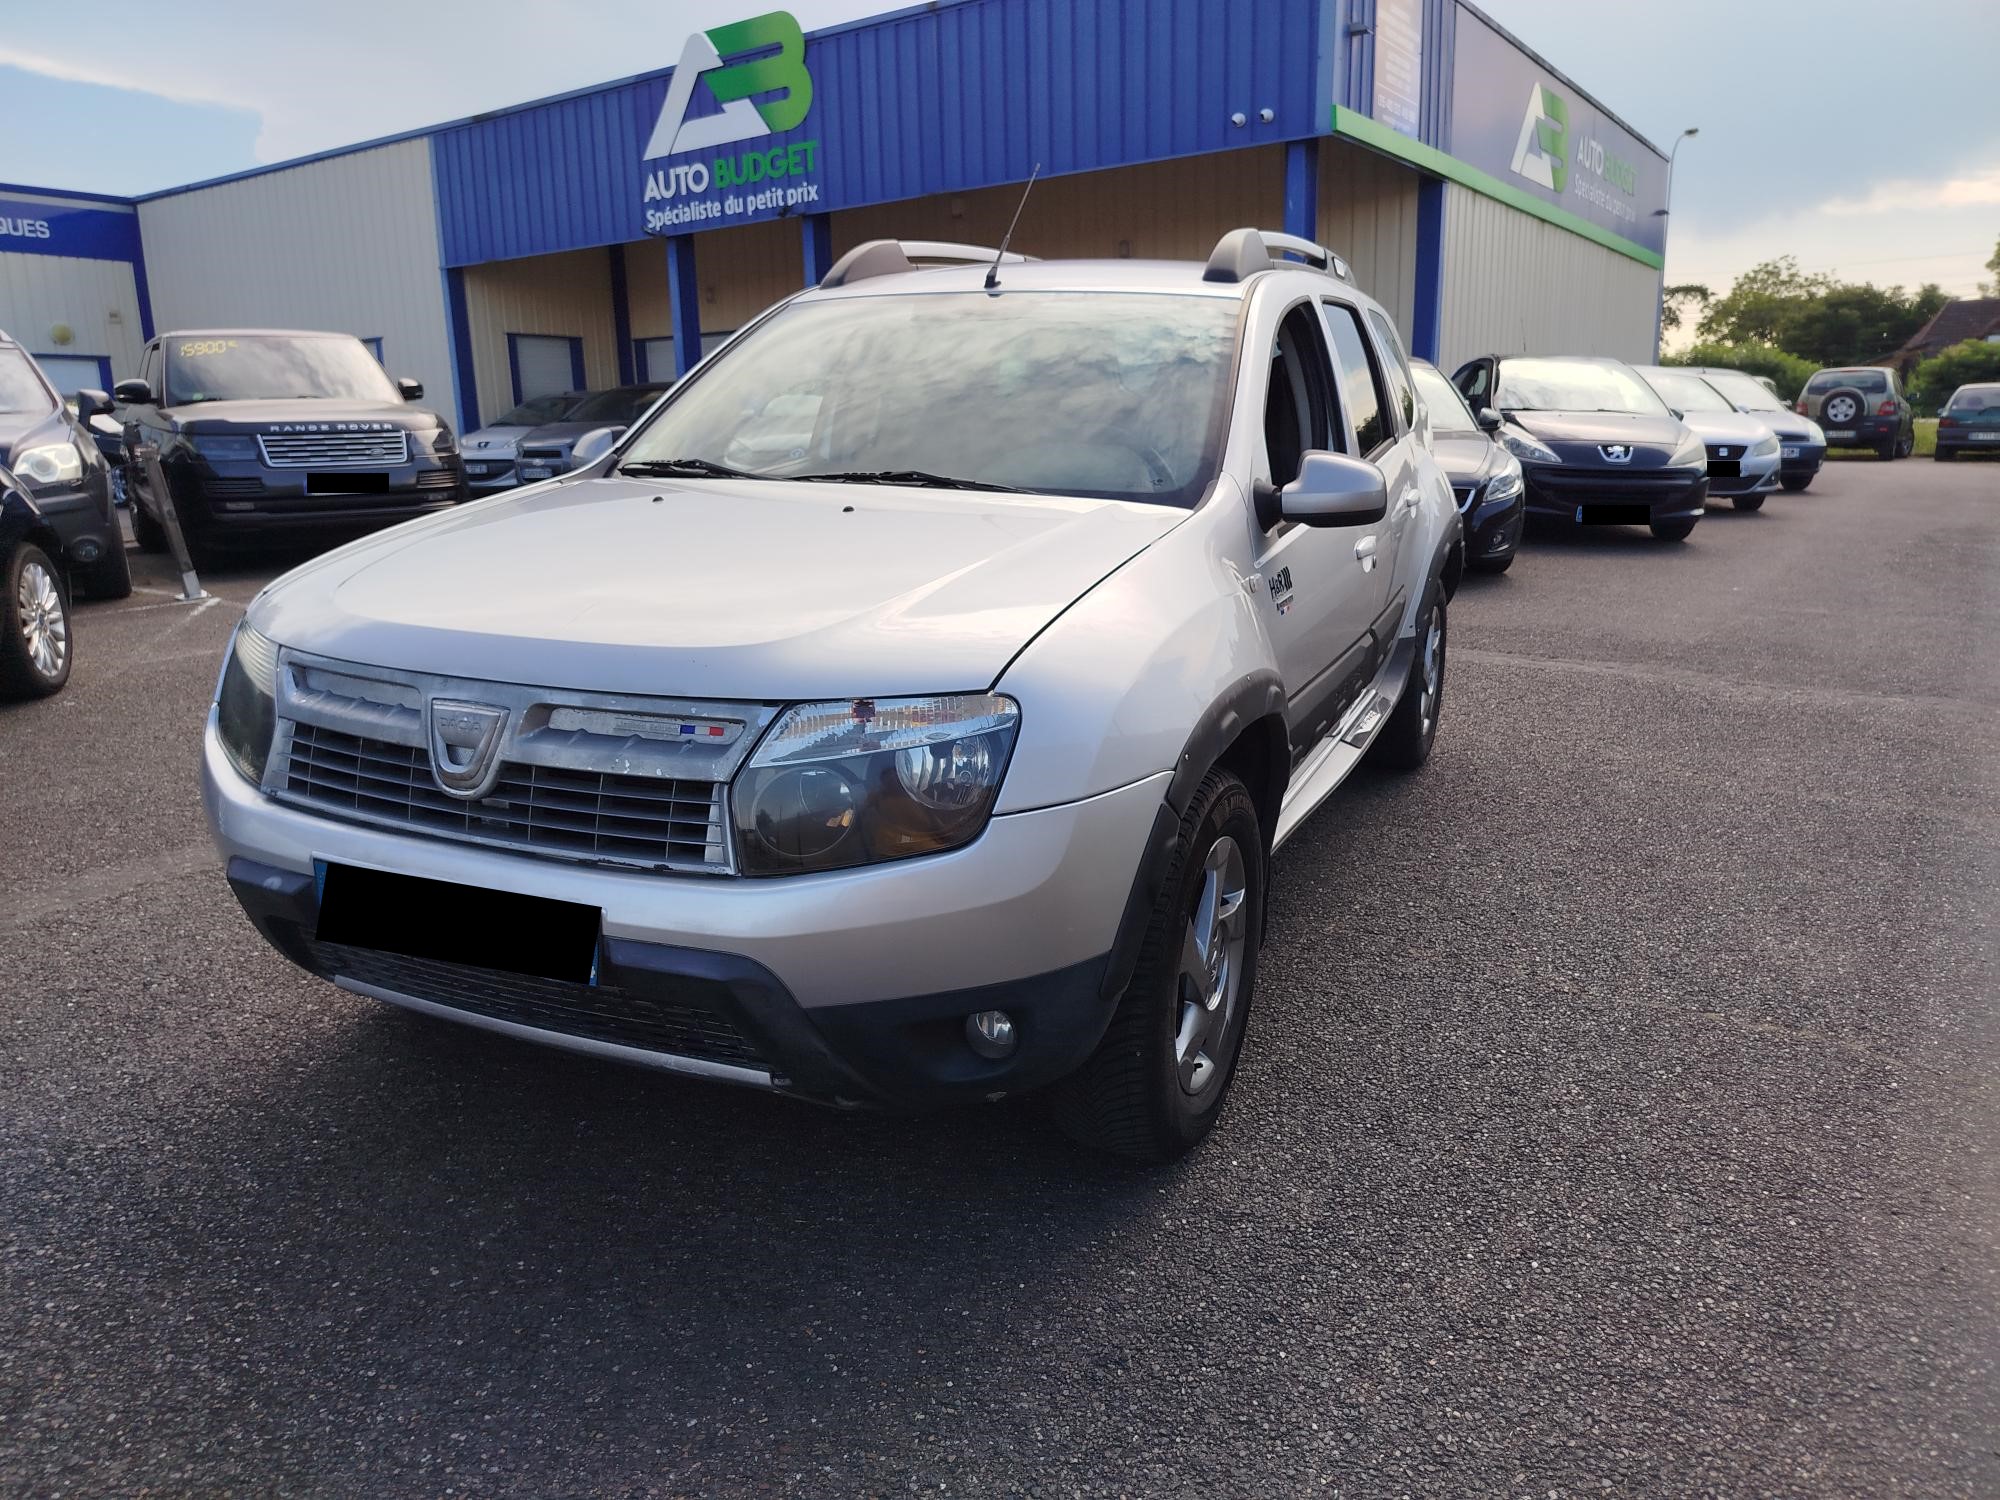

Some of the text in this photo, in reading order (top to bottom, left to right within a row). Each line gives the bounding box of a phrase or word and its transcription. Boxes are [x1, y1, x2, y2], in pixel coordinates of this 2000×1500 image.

[644, 140, 819, 202] AUTO BUDGET
[1577, 136, 1604, 176] AUTO
[646, 182, 819, 231] Spécialiste du petit prix
[270, 422, 393, 432] RANGE ROVER
